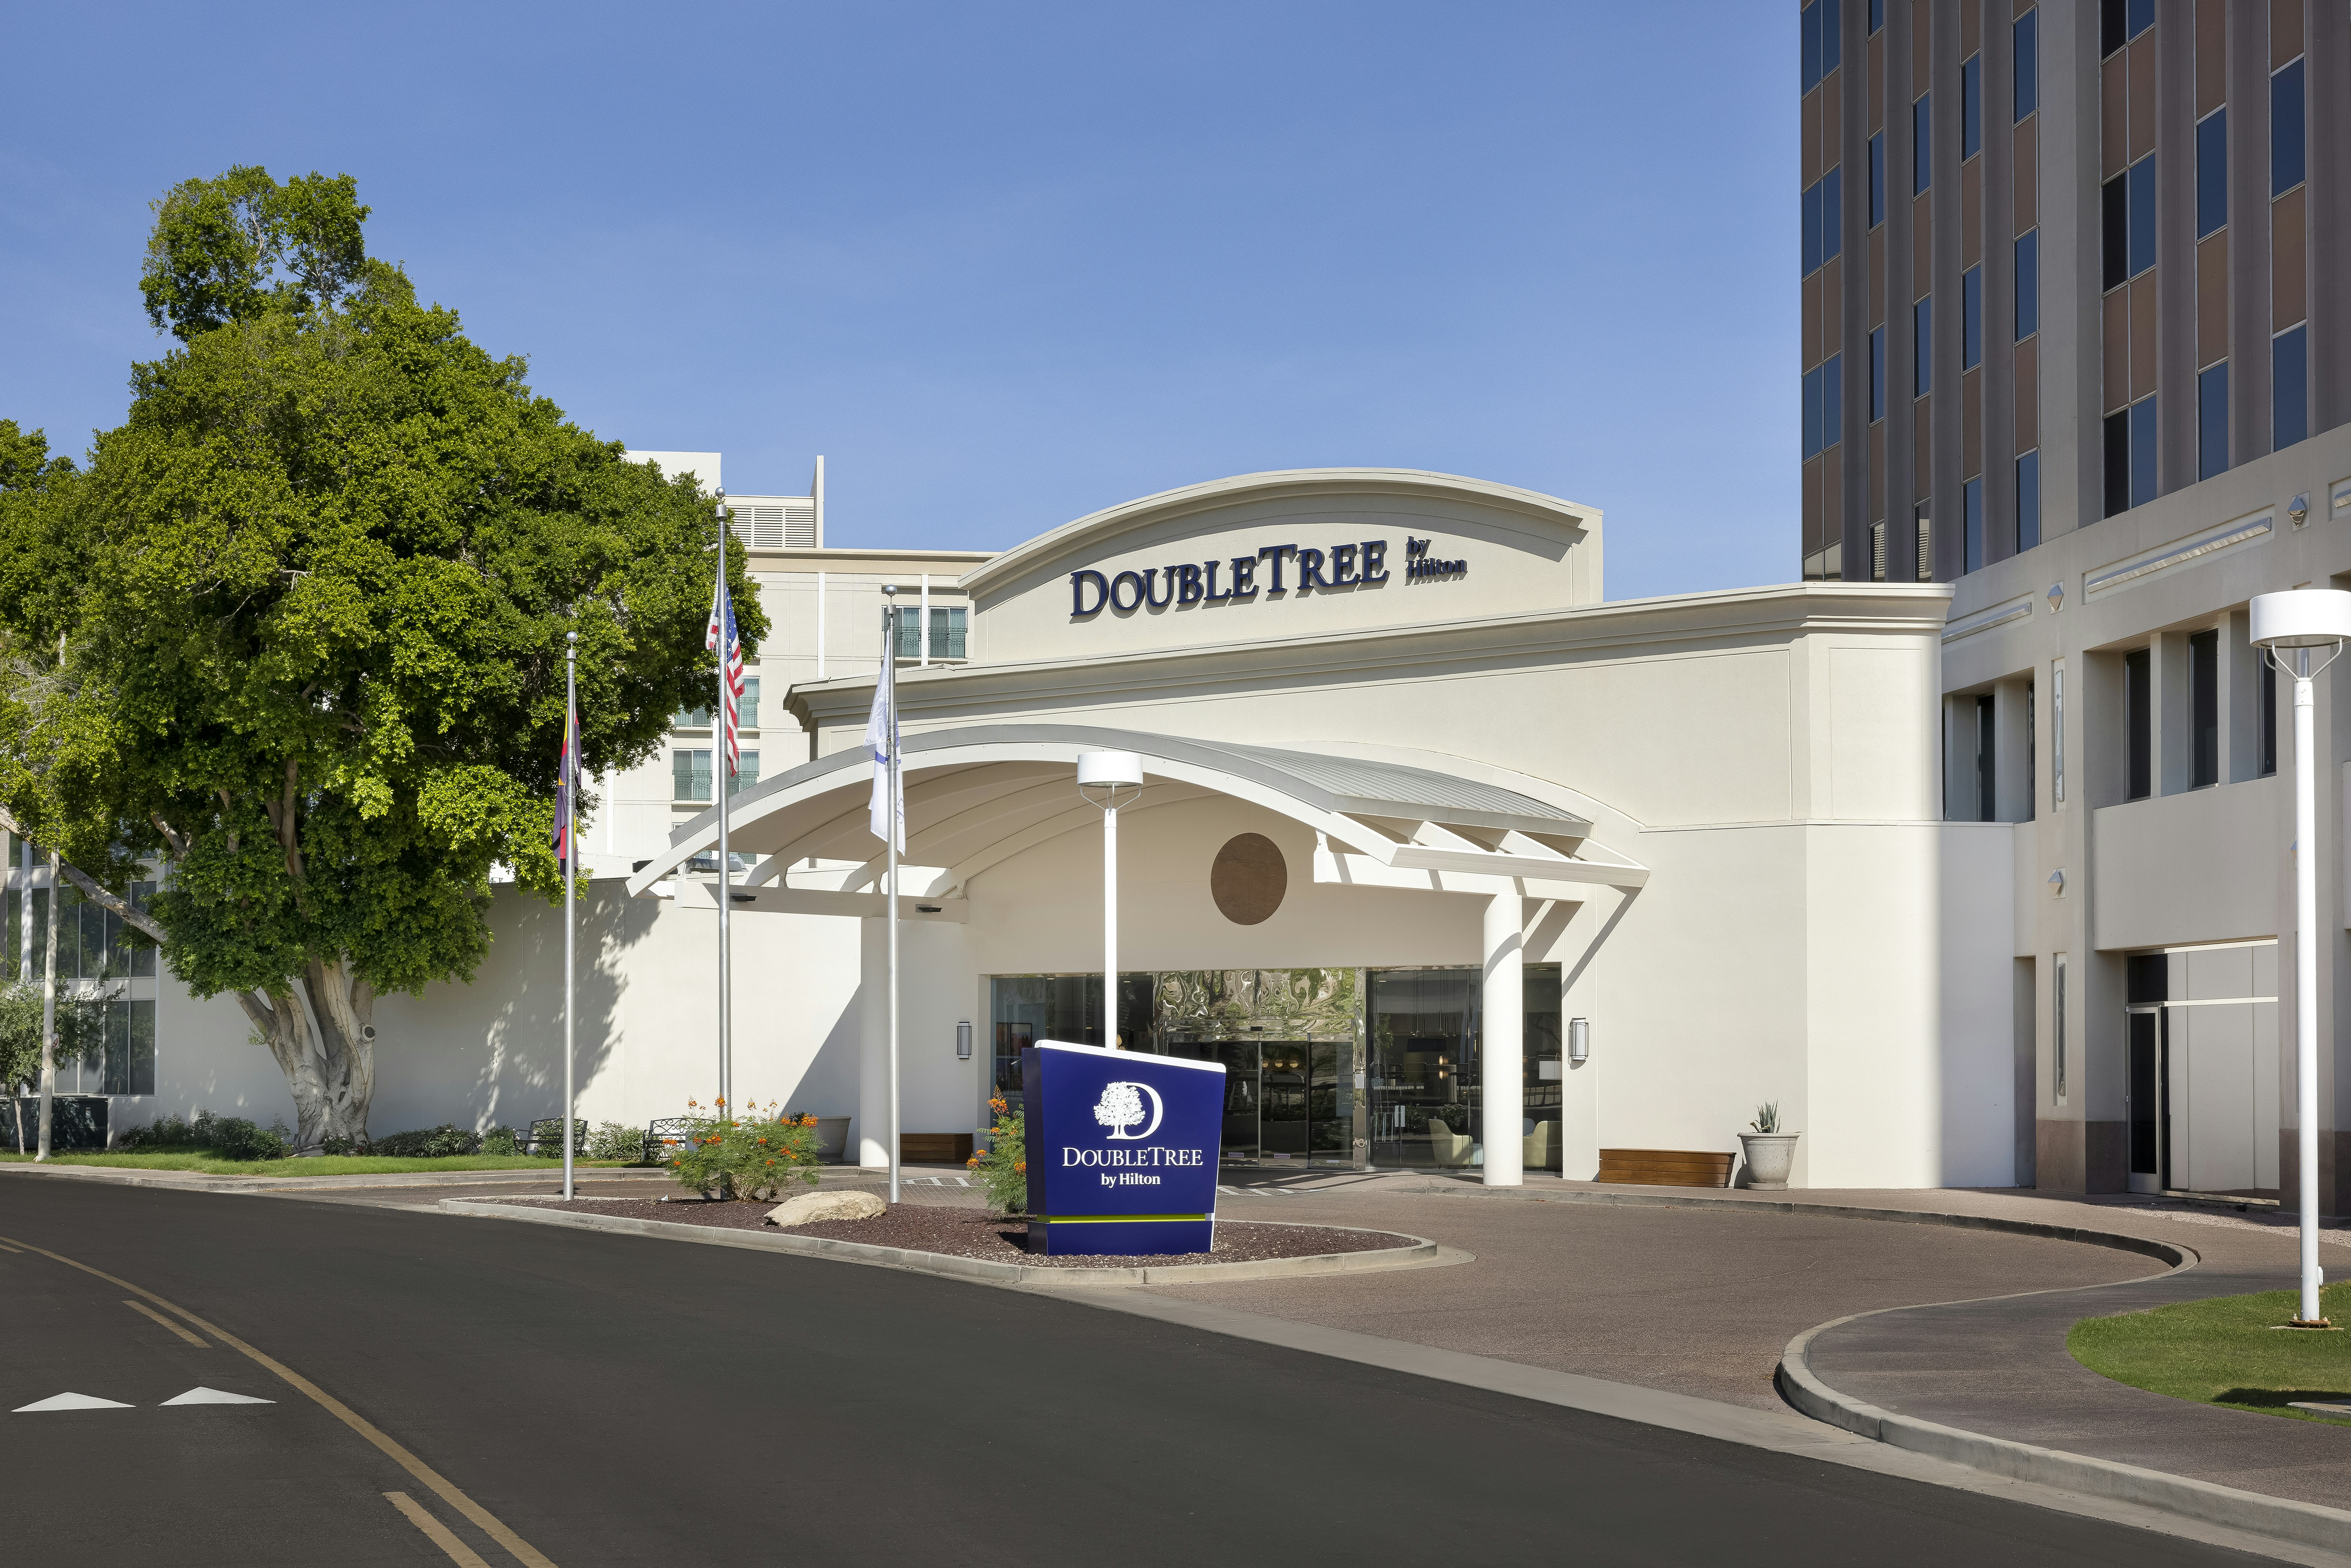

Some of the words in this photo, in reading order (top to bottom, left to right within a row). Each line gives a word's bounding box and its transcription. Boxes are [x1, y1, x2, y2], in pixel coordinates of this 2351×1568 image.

[1407, 536, 1431, 558] by
[1407, 558, 1467, 577] Hilton
[1070, 540, 1387, 617] DOUBLETREE
[1062, 1147, 1203, 1166] DOUBLETREE
[1101, 1173, 1117, 1188] by
[1119, 1173, 1161, 1185] Hilton
